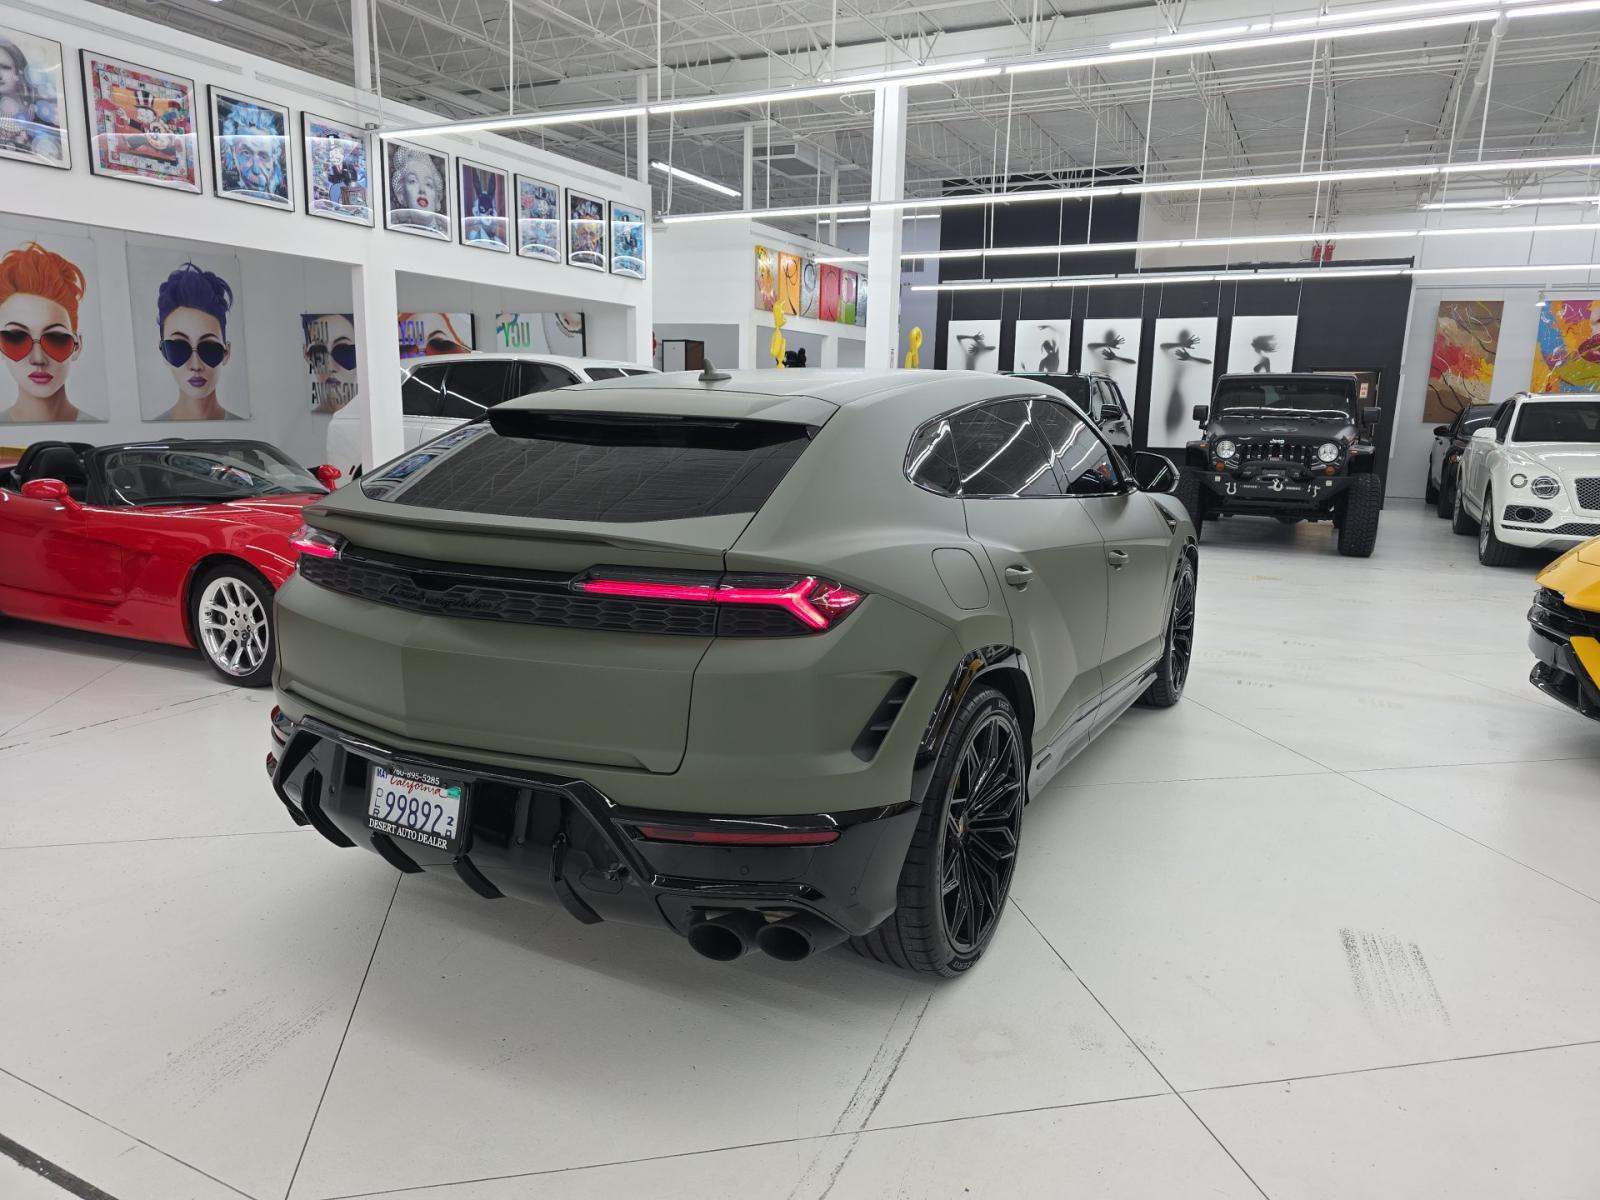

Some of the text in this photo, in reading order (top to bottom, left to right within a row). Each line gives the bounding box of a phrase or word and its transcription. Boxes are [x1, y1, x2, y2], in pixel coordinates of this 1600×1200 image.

[502, 321, 531, 348] YOU
[383, 791, 444, 837] 99892
[368, 818, 448, 850] DESERT AUTO DEALER
